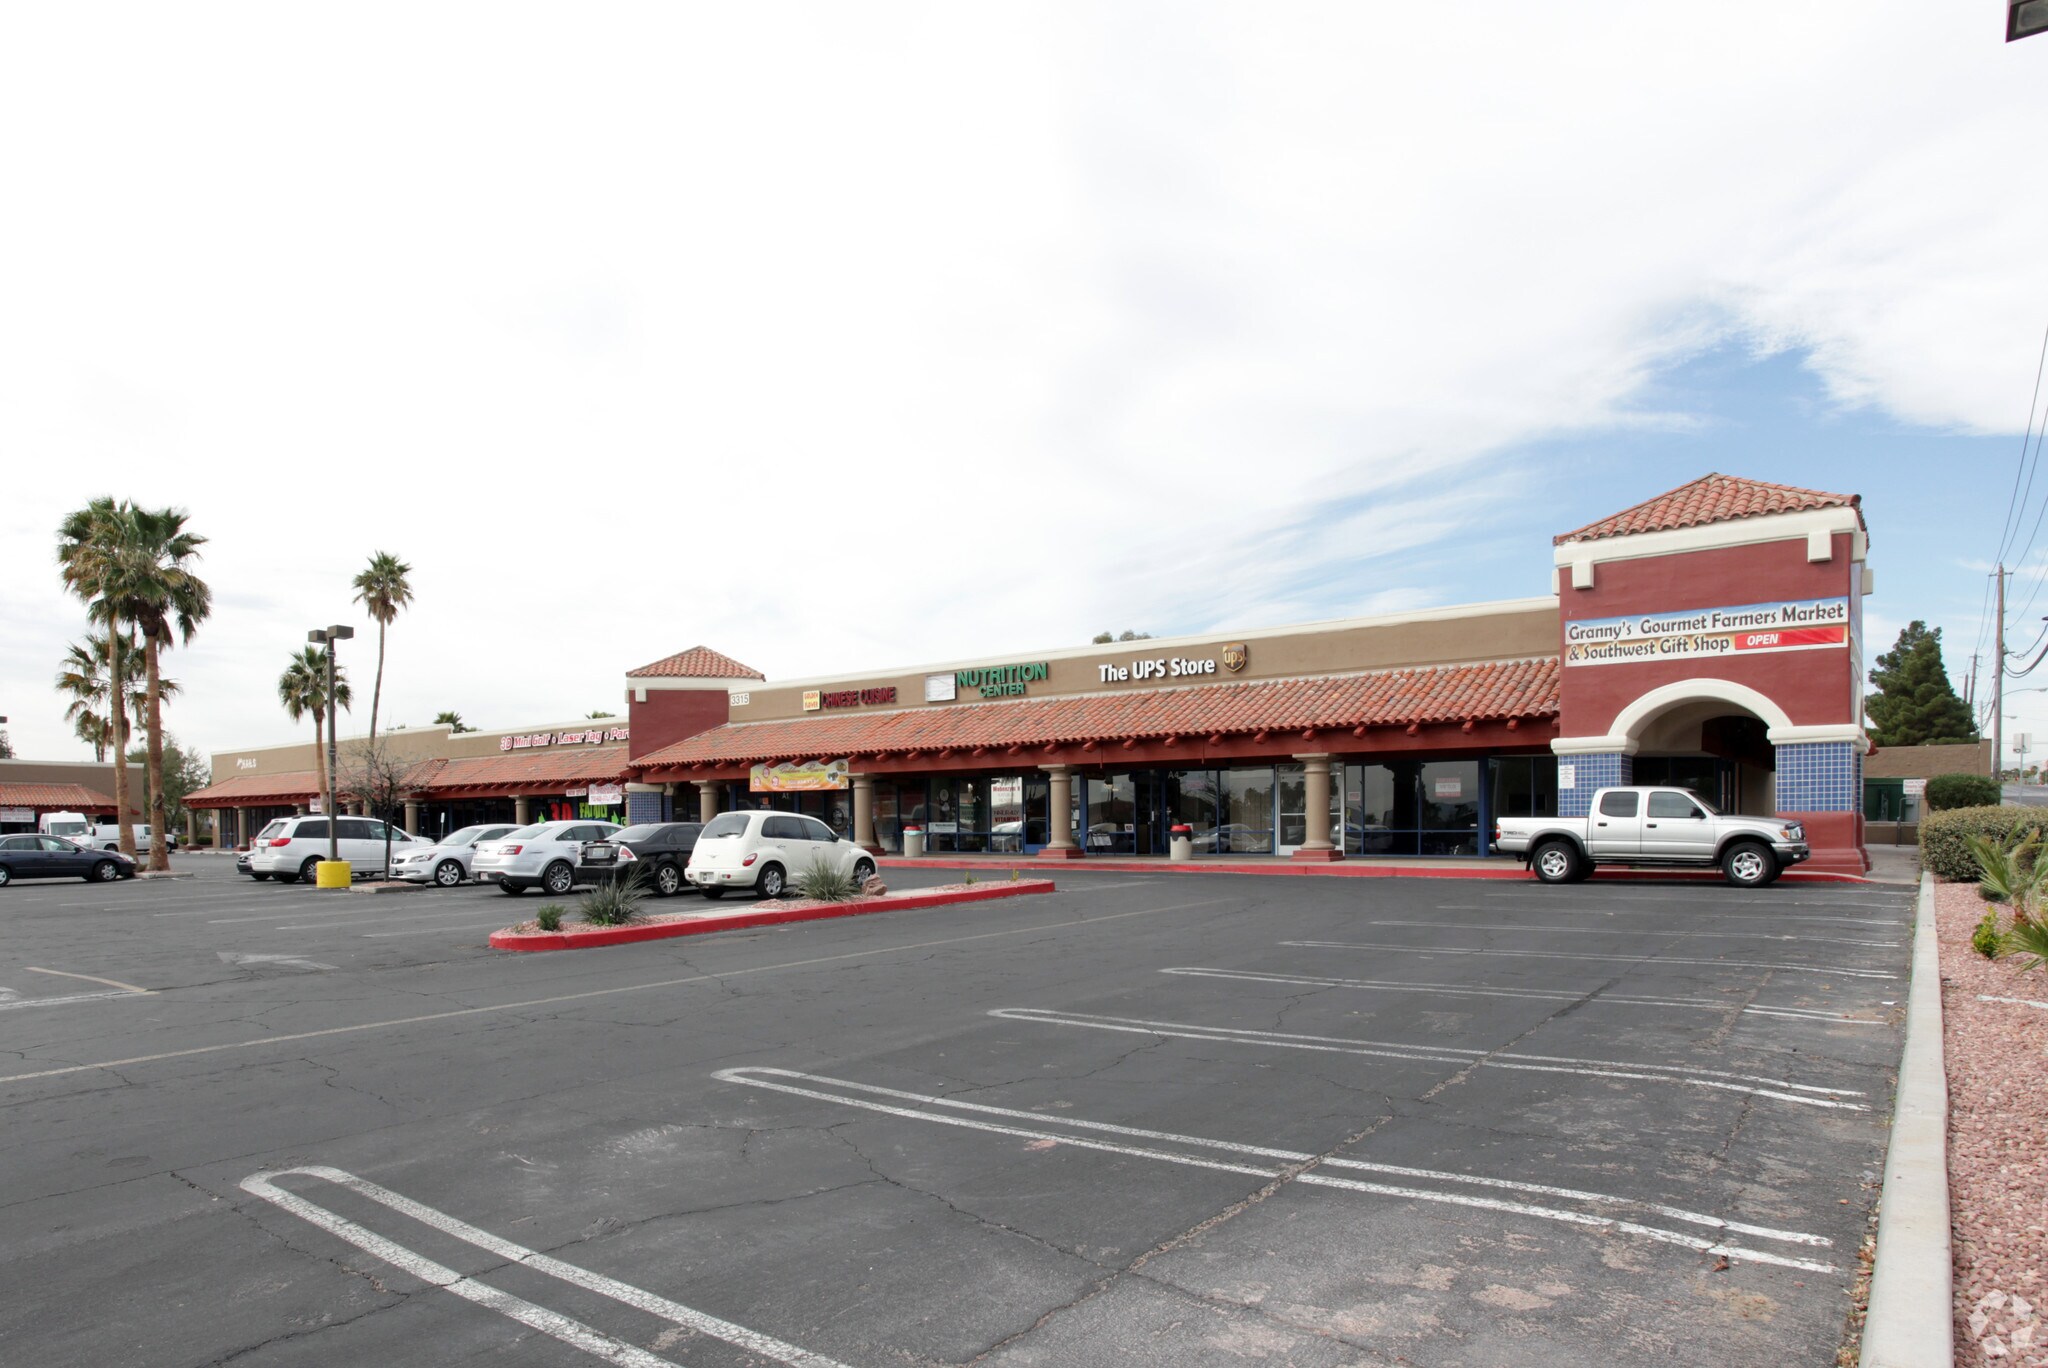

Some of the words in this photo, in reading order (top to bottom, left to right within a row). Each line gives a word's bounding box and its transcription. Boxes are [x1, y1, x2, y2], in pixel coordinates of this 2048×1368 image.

[1569, 622, 1632, 641] Granny's
[1640, 615, 1707, 634] Gourmet
[1712, 609, 1776, 629] Farmers
[1782, 603, 1844, 622] Market
[1569, 647, 1580, 661] &
[1584, 642, 1655, 660] Southwest
[1660, 637, 1688, 655] Gift
[1693, 635, 1730, 653] Shop
[1747, 634, 1779, 646] OPEN
[1223, 651, 1243, 666] ups
[957, 662, 1048, 687] NUTRITION
[1098, 664, 1128, 682] The
[1132, 659, 1166, 680] UPS
[1170, 658, 1216, 677] Store
[731, 694, 749, 705] 3315
[822, 690, 859, 708] CHINESE
[860, 686, 897, 705] CUISINE
[978, 682, 1025, 698] CENTER
[500, 736, 512, 751] 3D
[513, 736, 532, 748] Mini
[532, 733, 552, 747] Golf
[558, 732, 585, 745] Laser
[585, 730, 602, 744] Tag
[1168, 771, 1180, 779] A4
